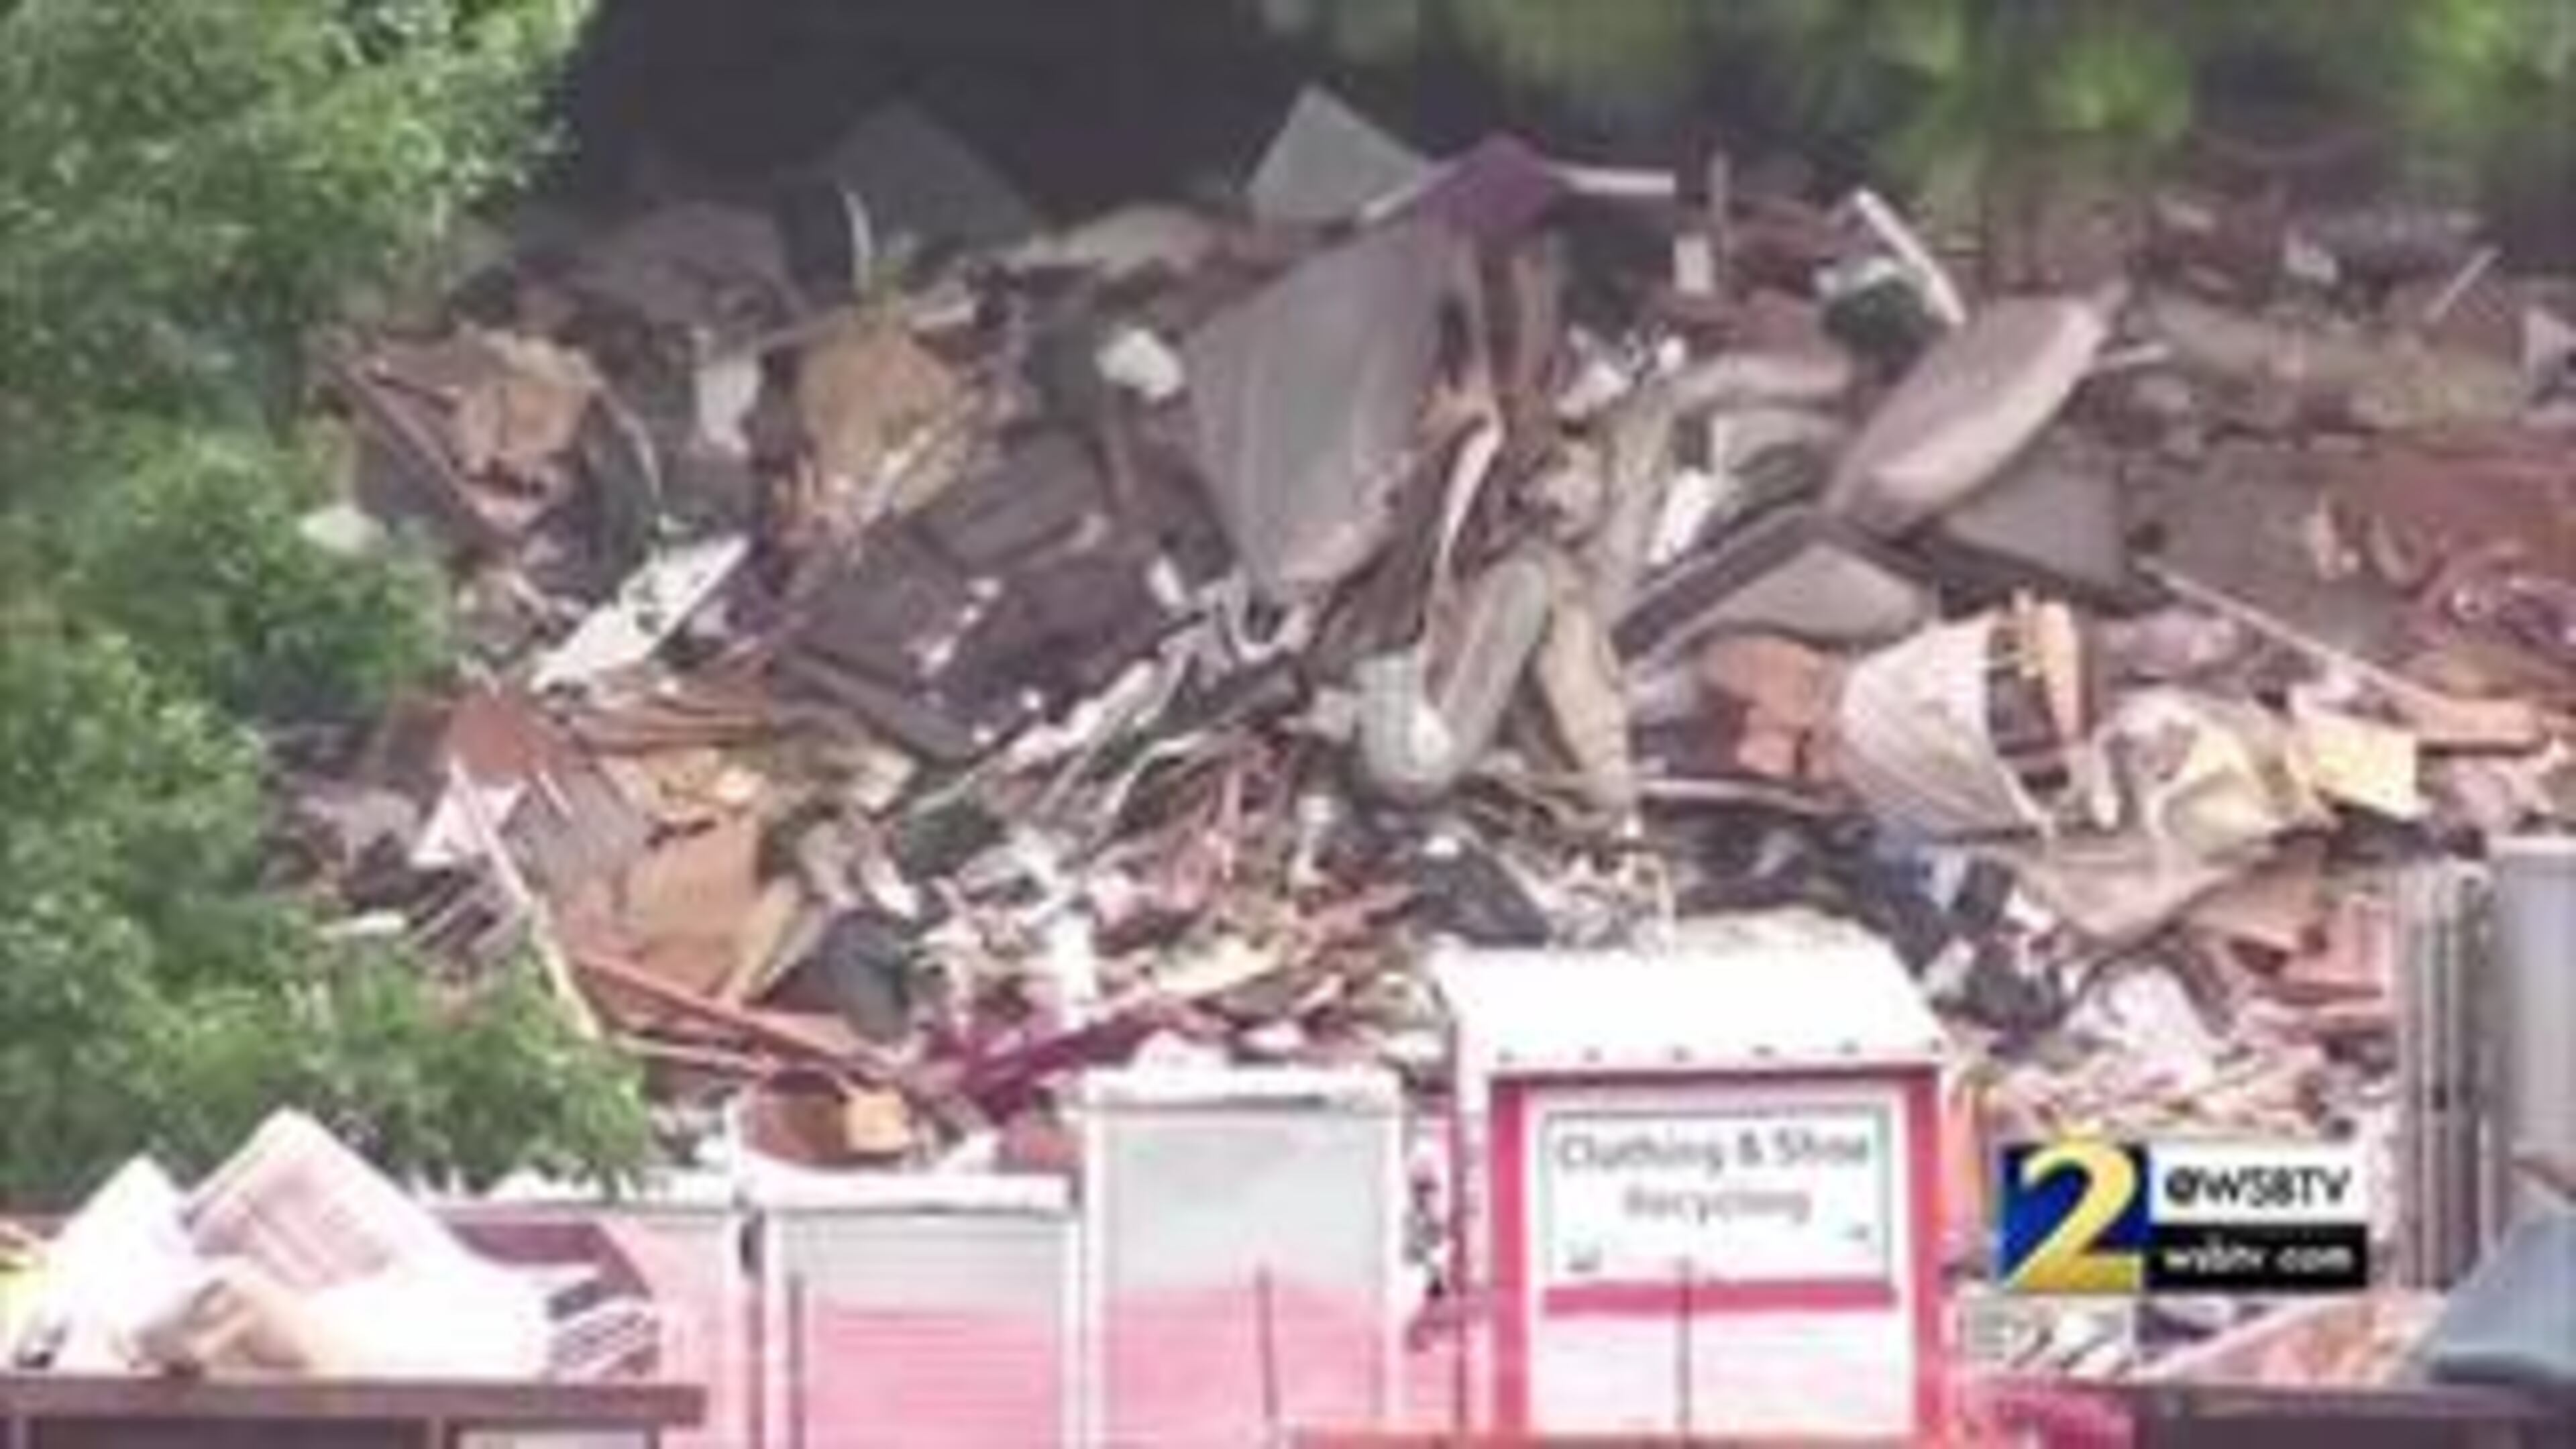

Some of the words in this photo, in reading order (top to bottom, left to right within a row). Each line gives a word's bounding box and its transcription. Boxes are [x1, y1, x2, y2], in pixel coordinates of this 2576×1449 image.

[1559, 1130, 1723, 1177] Clothing
[1739, 1131, 1762, 1167] &
[1774, 1130, 1870, 1165] Shoe
